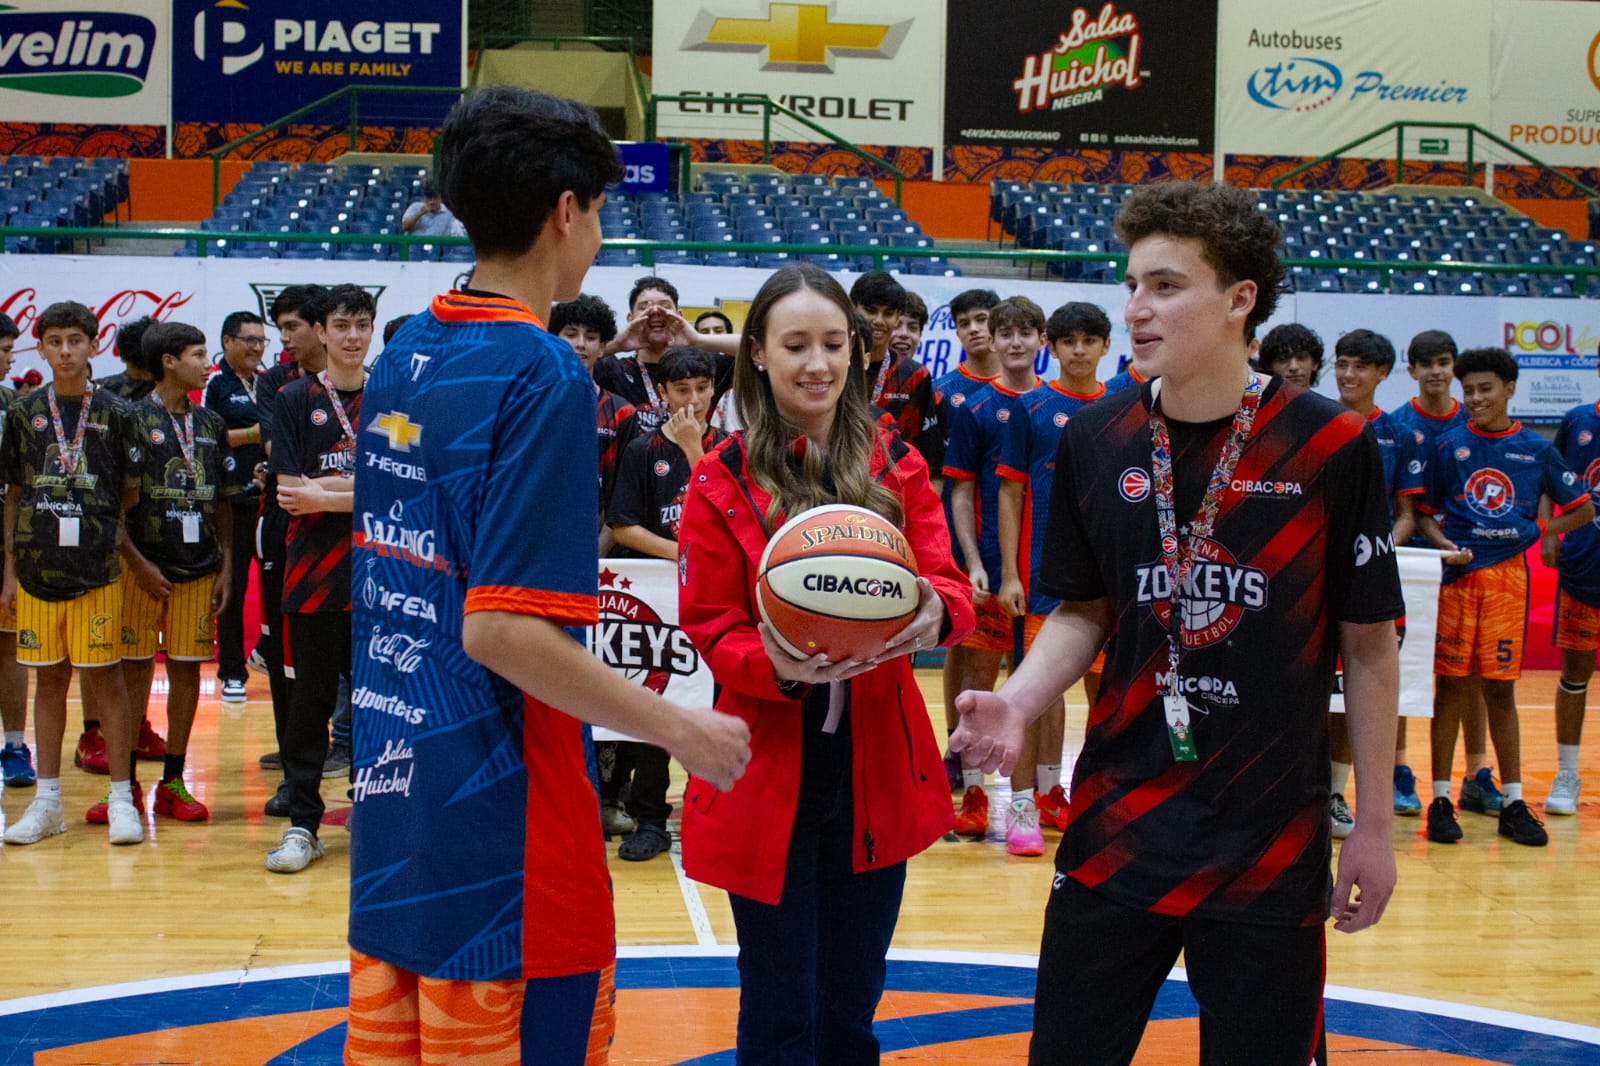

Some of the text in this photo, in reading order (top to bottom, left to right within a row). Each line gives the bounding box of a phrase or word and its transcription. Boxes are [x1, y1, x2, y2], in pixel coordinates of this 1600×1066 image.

[274, 18, 440, 54] PIAGET
[1055, 3, 1137, 54] Salsa
[1248, 28, 1343, 50] Autobuses
[275, 60, 412, 78] WE ARE FAMILY
[1013, 34, 1140, 111] Huichol
[1052, 89, 1103, 111] NEGRA
[1351, 71, 1469, 103] Premier
[1113, 133, 1200, 147] salsahuichol.com
[1509, 123, 1600, 146] PRODU
[1503, 319, 1577, 355] POOL
[1231, 479, 1303, 496] CIBACOPA
[800, 524, 908, 561] SPALDING
[803, 573, 904, 599] CIBACOPA
[586, 622, 695, 674] KEYS
[1496, 639, 1513, 663] 5
[350, 685, 427, 726] dporteis
[374, 738, 414, 769] Salsa
[352, 762, 414, 802] Huichol
